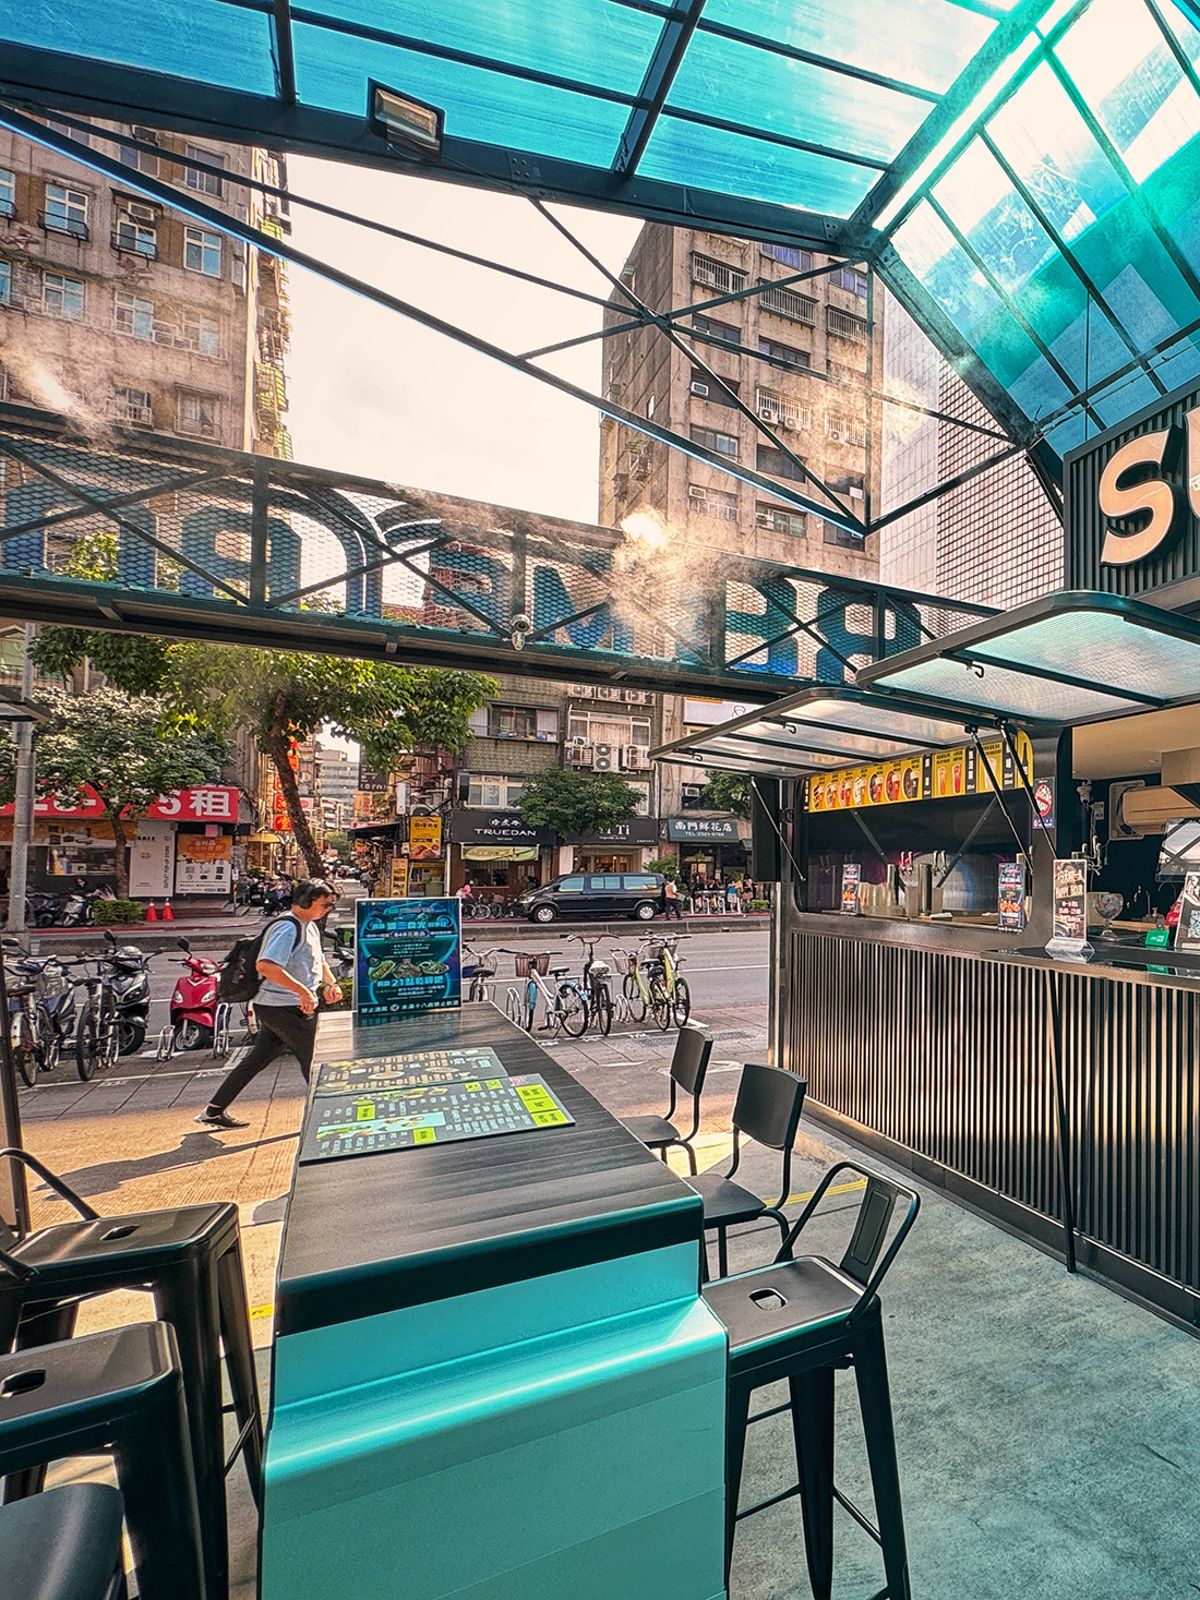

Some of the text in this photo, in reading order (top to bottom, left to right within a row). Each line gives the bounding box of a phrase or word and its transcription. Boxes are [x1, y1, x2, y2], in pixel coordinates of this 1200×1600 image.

[674, 821, 732, 832] 南門鮮花店
[474, 828, 536, 836] TRUEDAN
